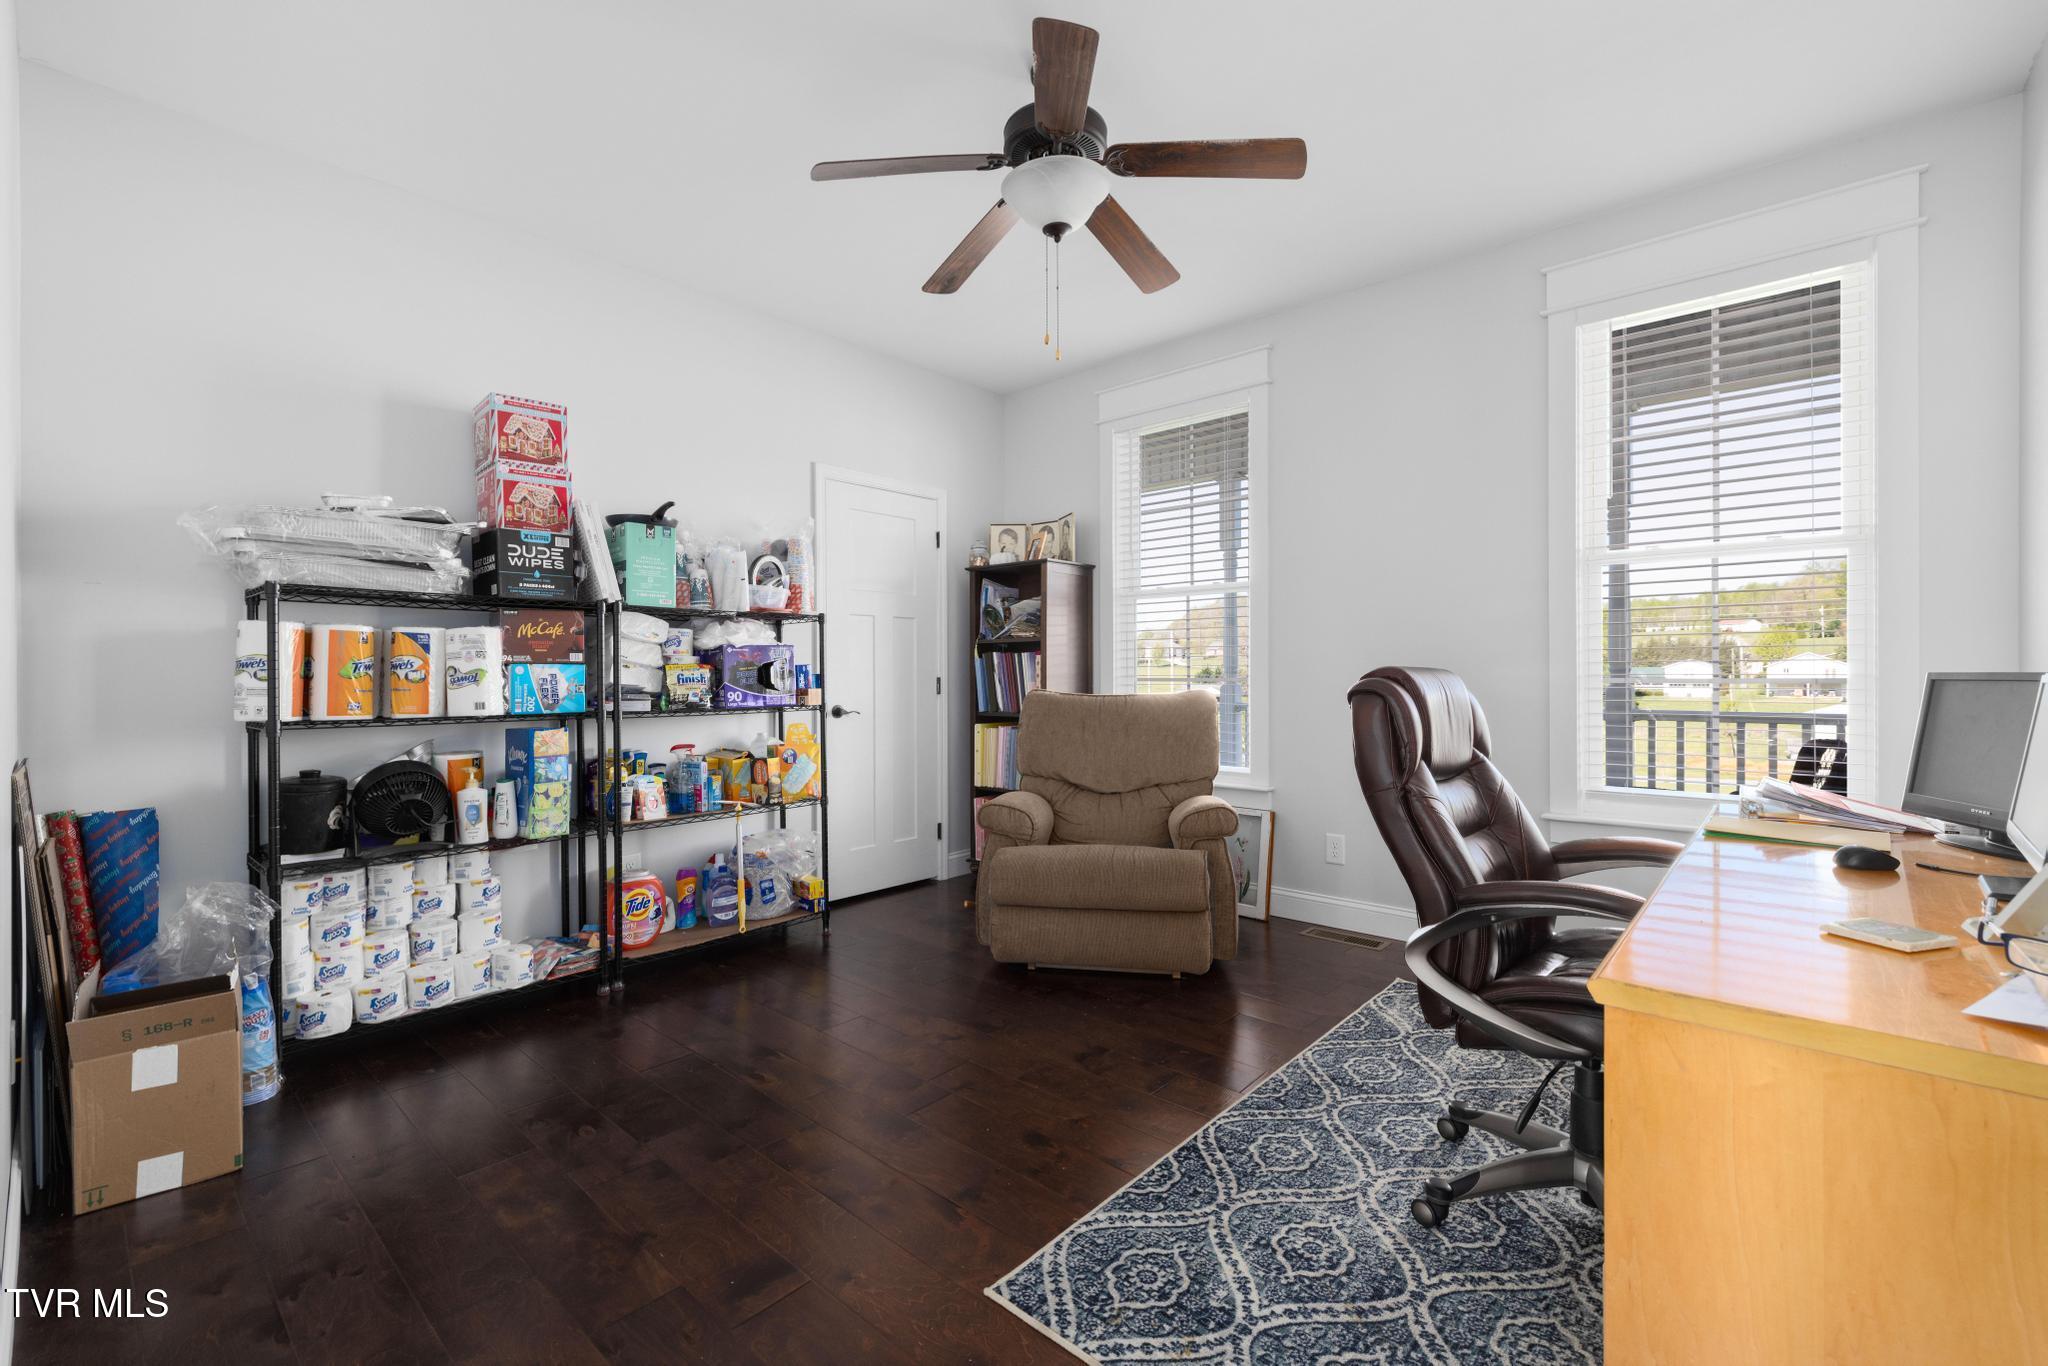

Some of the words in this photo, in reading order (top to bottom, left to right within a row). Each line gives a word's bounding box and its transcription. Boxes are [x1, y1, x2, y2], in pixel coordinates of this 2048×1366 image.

[507, 544, 564, 560] DUDE
[508, 557, 564, 569] WIPES
[352, 661, 374, 673] Tow
[677, 673, 707, 684] finish
[727, 690, 743, 701] 90
[527, 696, 535, 712] 200
[625, 896, 651, 917] Tide
